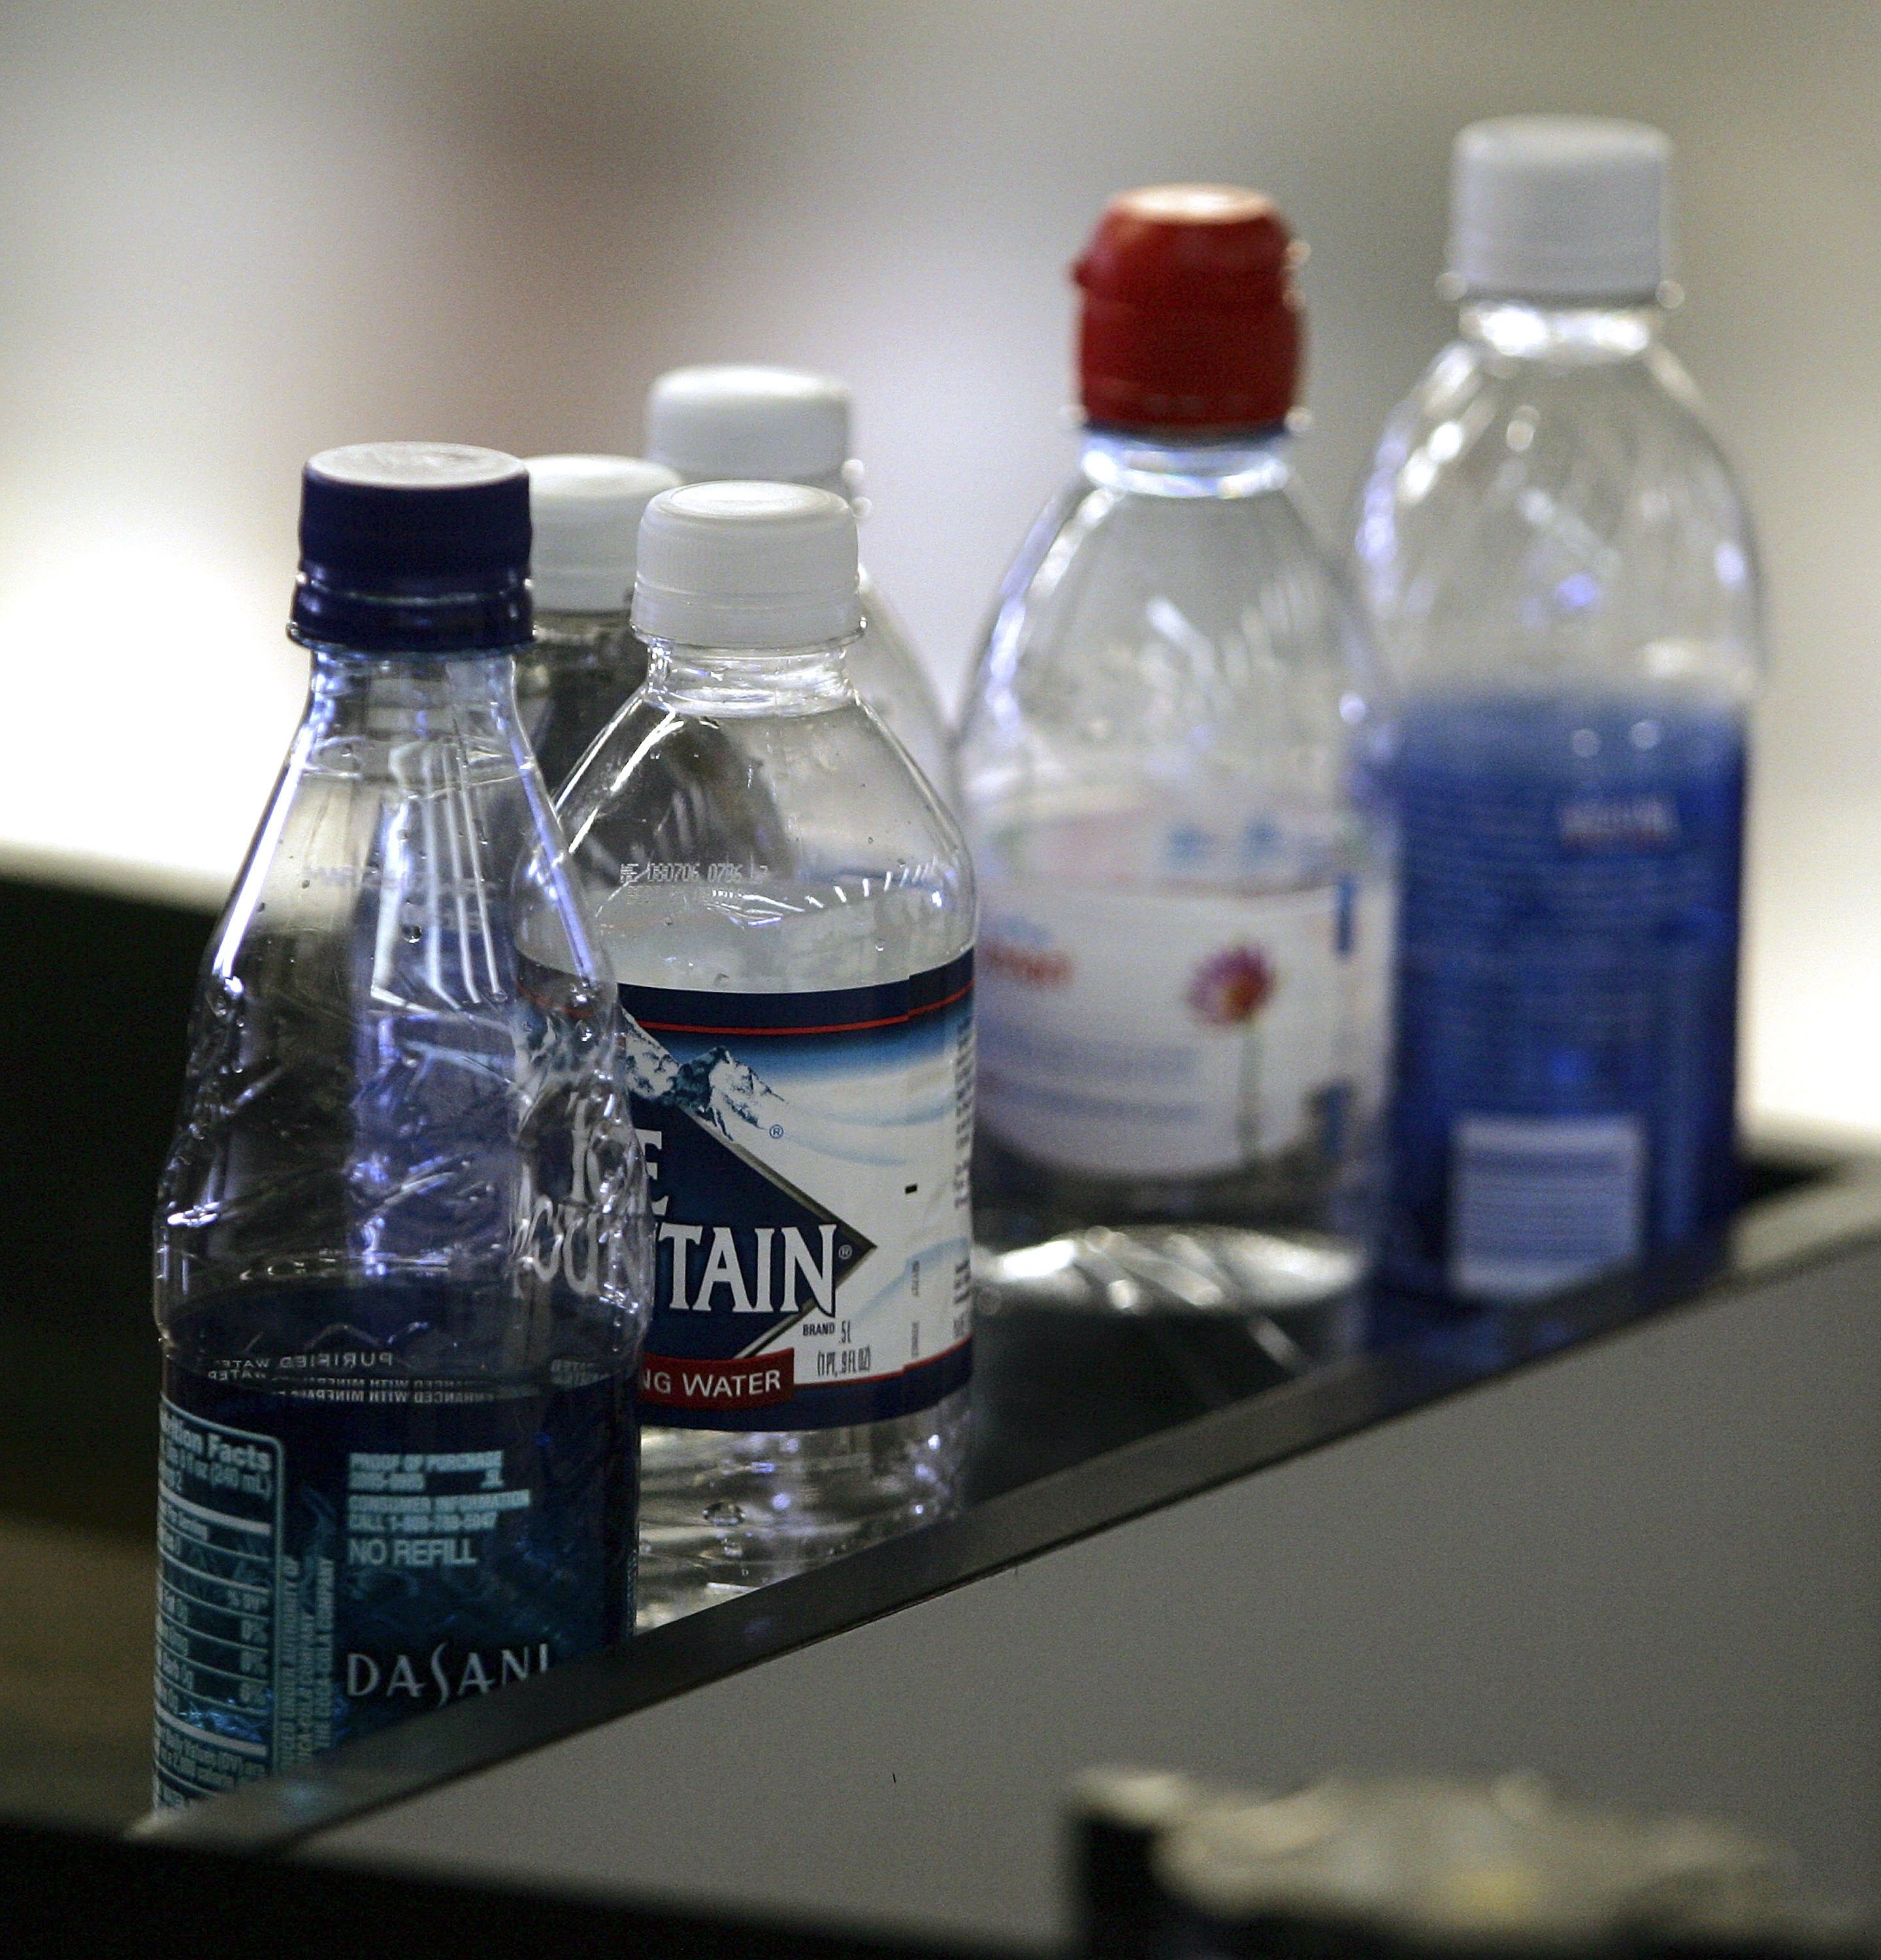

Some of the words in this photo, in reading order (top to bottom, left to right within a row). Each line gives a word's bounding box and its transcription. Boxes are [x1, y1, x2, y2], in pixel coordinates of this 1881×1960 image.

[802, 1322, 836, 1336] BRAND
[682, 1369, 781, 1397] WATER
[206, 1432, 271, 1472] Facts
[348, 1537, 387, 1566] NO
[393, 1537, 479, 1566] REFILL
[346, 1641, 549, 1707] DASANI
